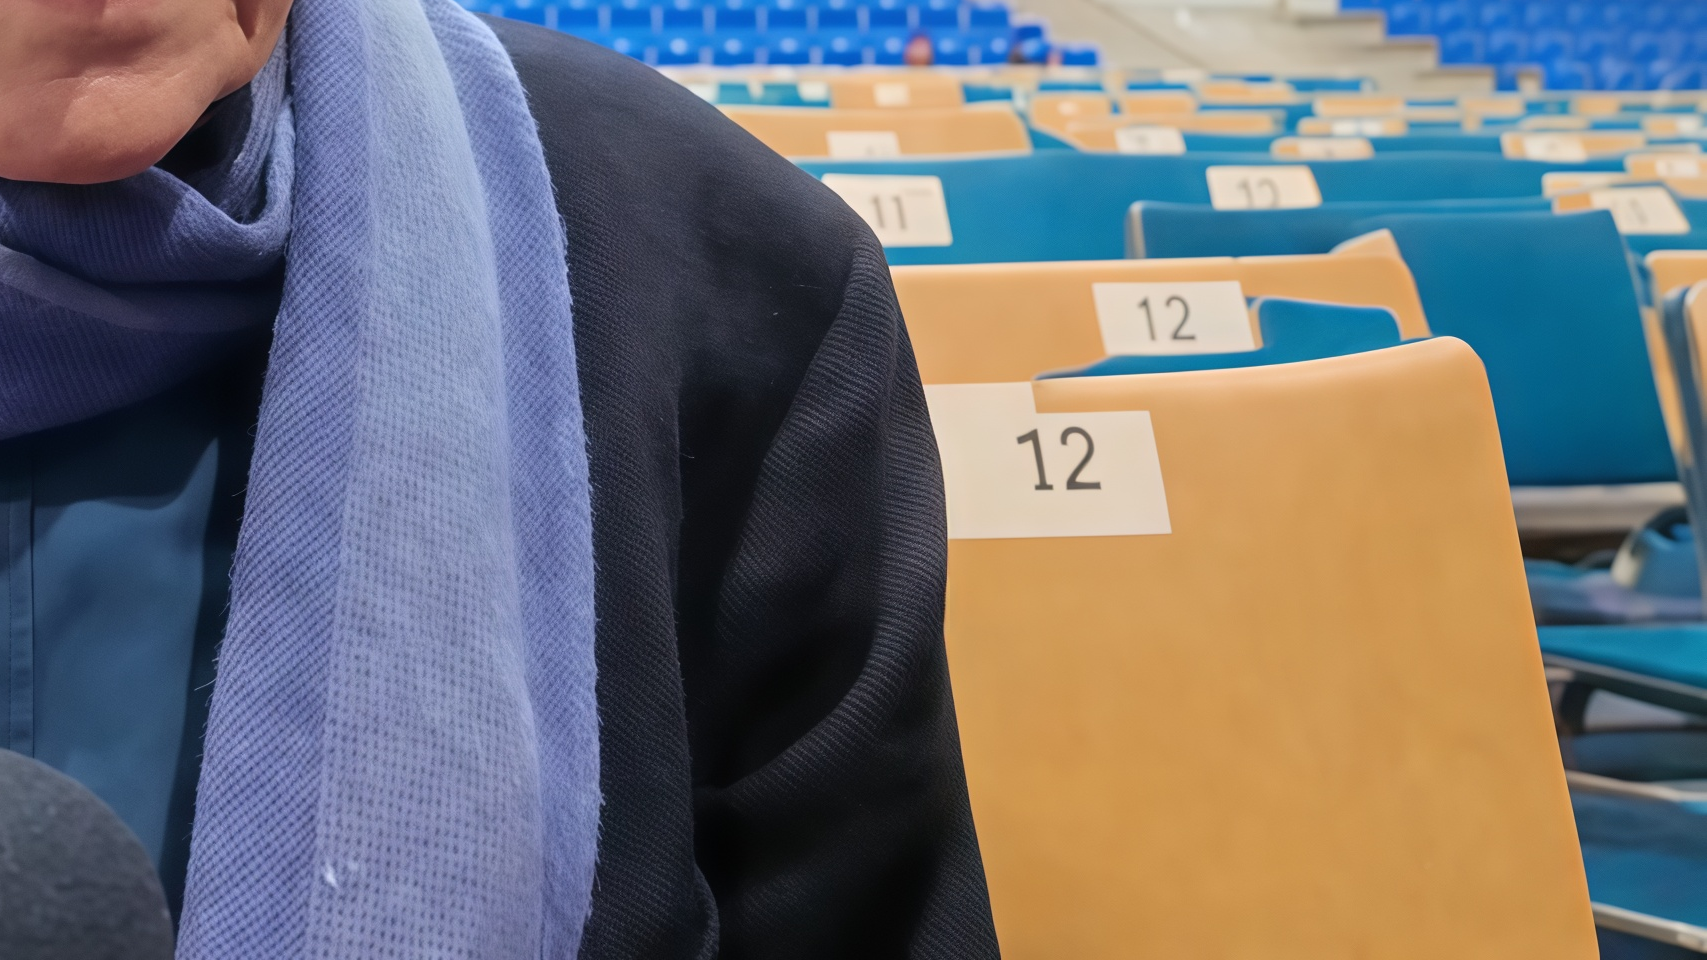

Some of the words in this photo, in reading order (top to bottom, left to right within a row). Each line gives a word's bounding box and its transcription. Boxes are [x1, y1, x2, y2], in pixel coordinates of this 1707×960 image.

[871, 194, 907, 230] 11
[1137, 295, 1196, 341] 12
[1016, 426, 1102, 491] 12
